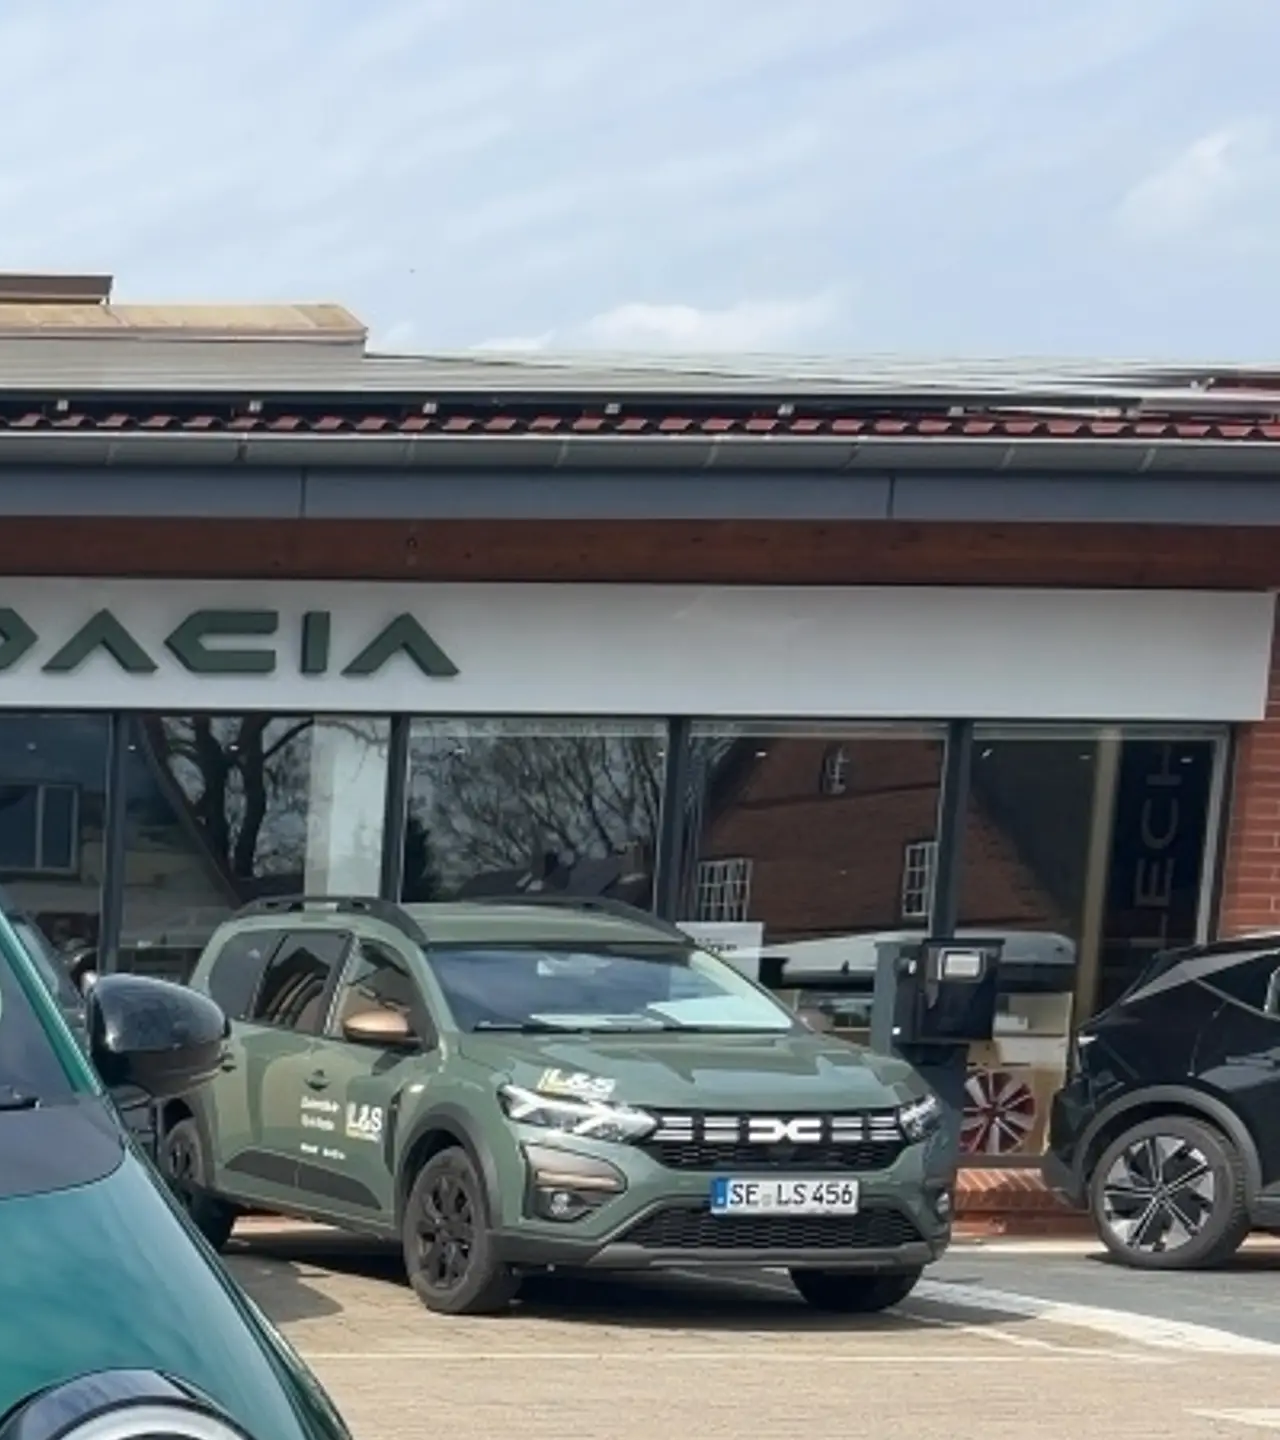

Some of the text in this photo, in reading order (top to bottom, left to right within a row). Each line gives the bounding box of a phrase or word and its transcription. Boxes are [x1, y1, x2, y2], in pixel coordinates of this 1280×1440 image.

[730, 1184, 853, 1206] SE LS 456
